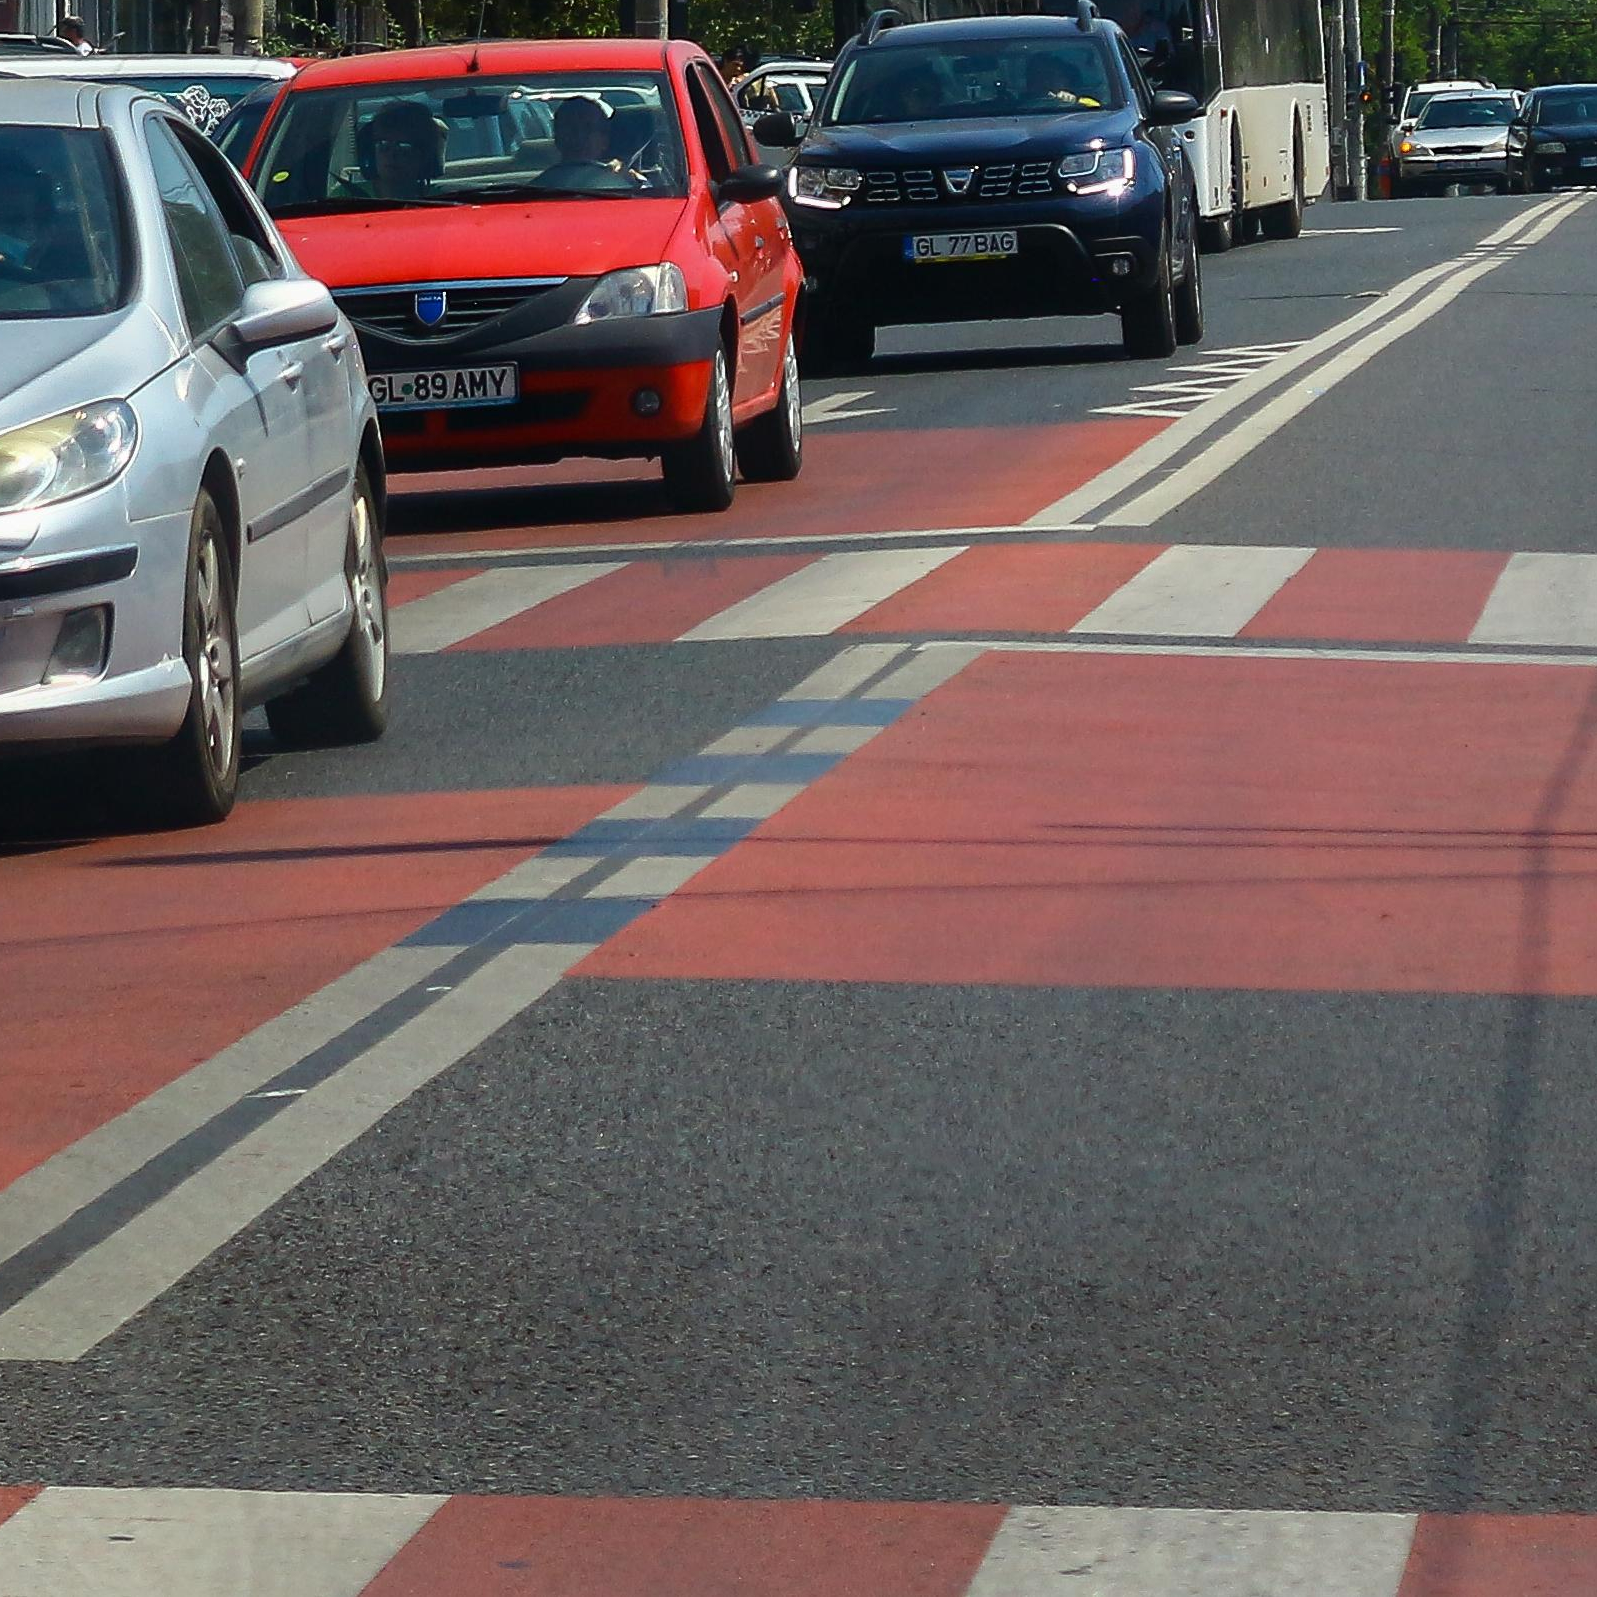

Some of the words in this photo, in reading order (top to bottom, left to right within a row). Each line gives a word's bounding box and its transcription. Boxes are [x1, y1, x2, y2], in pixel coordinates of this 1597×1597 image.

[915, 237, 941, 256] GL
[948, 236, 972, 255] 77
[975, 233, 1016, 253] BAG
[369, 375, 405, 403] GL
[413, 372, 447, 401] 89
[452, 368, 508, 400] AMY
